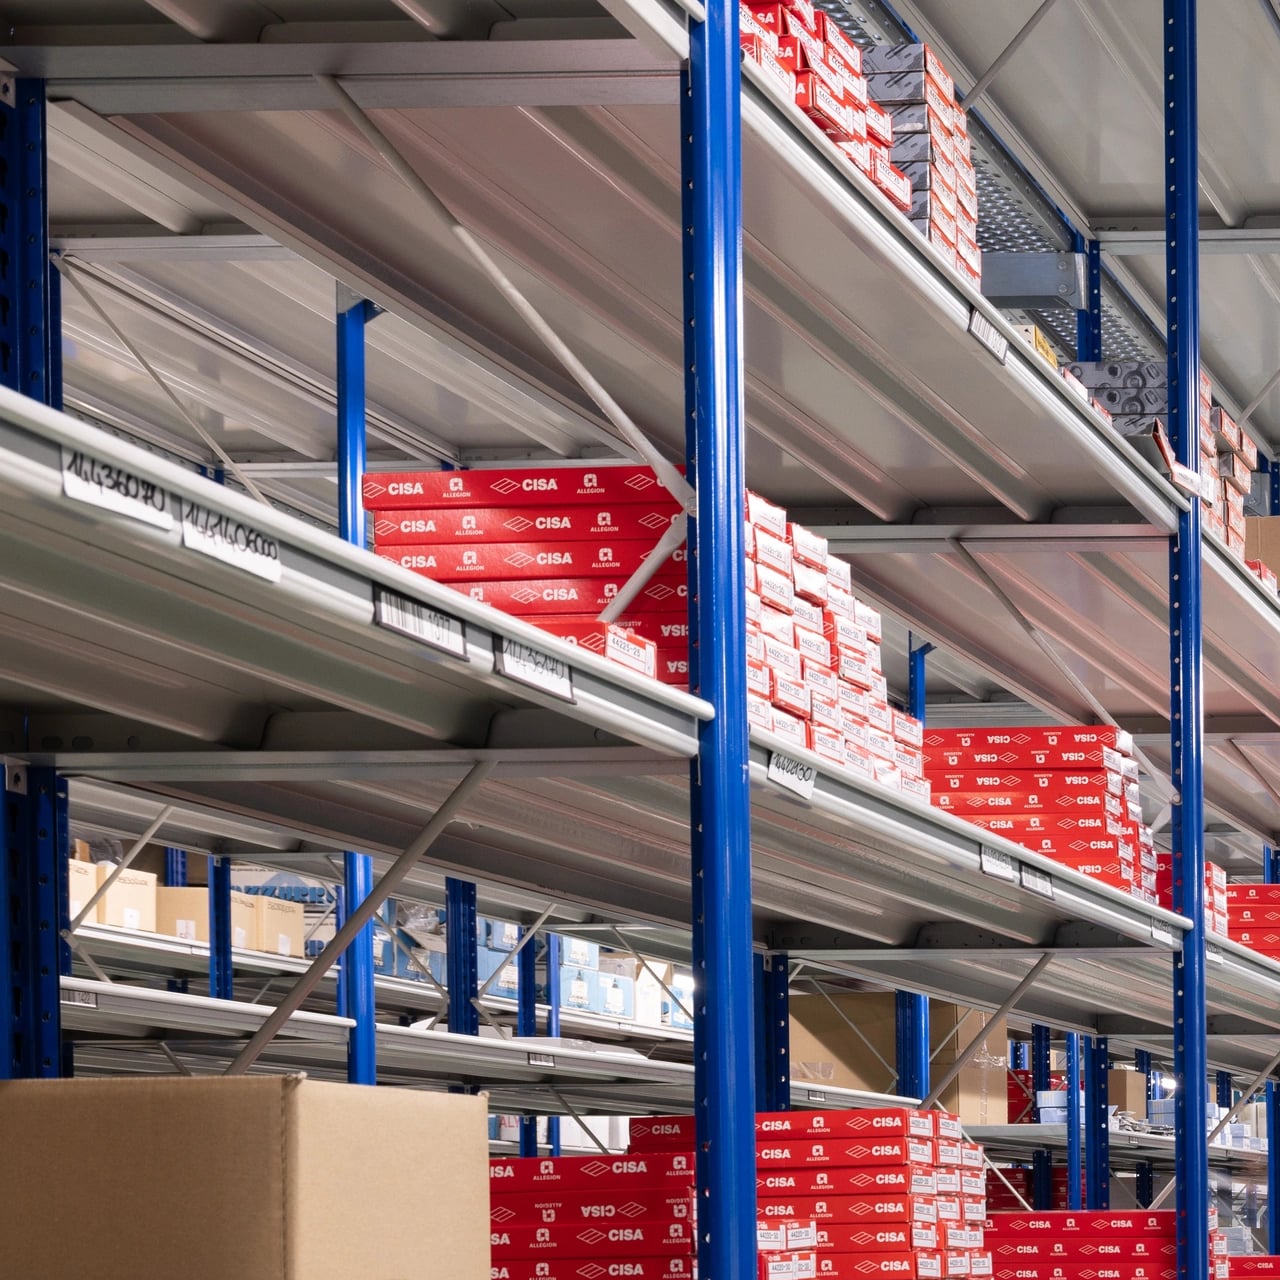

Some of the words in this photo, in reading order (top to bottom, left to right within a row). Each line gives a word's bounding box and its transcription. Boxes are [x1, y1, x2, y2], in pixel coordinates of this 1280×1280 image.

[388, 483, 423, 495] CISA
[522, 479, 558, 490] CISA
[401, 520, 436, 532] CISA
[401, 556, 436, 568] CISA
[543, 588, 578, 600] CISA
[1062, 753, 1085, 761] CISA
[1078, 819, 1101, 827] CISA
[1090, 841, 1113, 849] CISA
[652, 1125, 680, 1134] CISA
[762, 1121, 791, 1131] CISA
[612, 1162, 647, 1173] CISA
[876, 1175, 905, 1184] CISA
[1029, 1220, 1051, 1229] CISA
[1111, 1220, 1132, 1228] CISA
[1017, 1246, 1038, 1254] CISA
[1098, 1246, 1120, 1254] CISA
